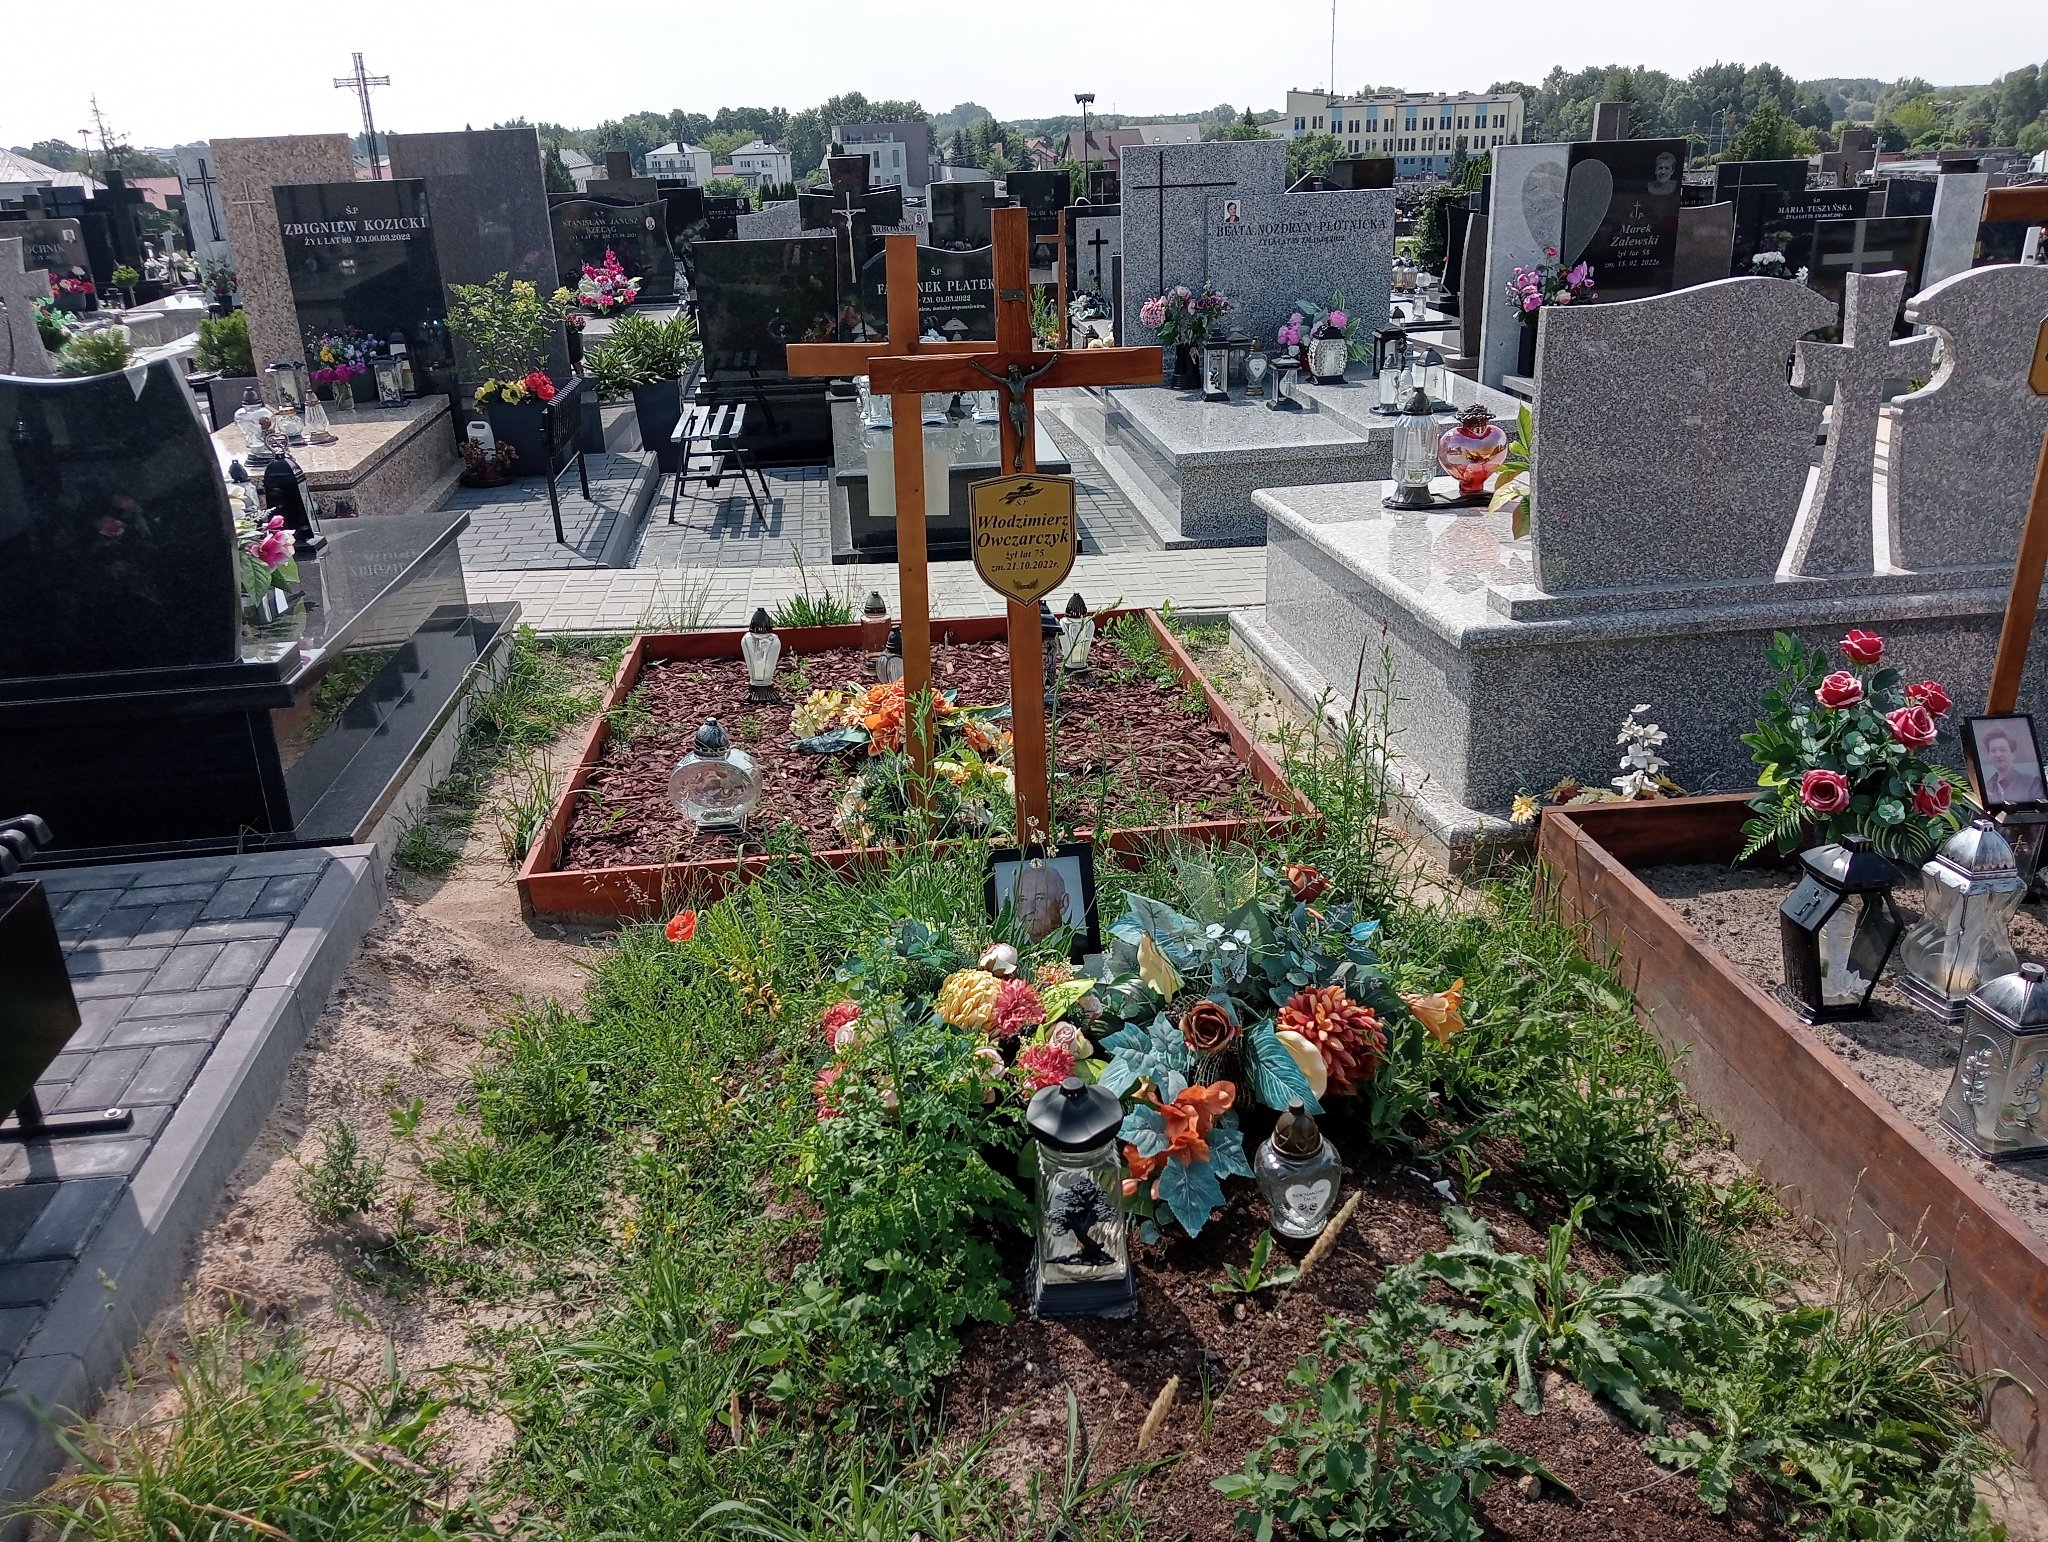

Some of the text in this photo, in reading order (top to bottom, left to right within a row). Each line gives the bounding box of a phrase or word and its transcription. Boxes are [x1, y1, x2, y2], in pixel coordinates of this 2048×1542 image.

[283, 217, 427, 235] ZBIGNIEW KOZICKI
[1216, 224, 1251, 237] BEATA
[1620, 224, 1651, 234] Marek
[324, 236, 340, 245] LAT
[1610, 235, 1660, 247] Zalewski
[978, 513, 1069, 530] Włodzimierz
[977, 529, 1069, 548] Owczarczyk
[1005, 549, 1045, 561] żył lat 75
